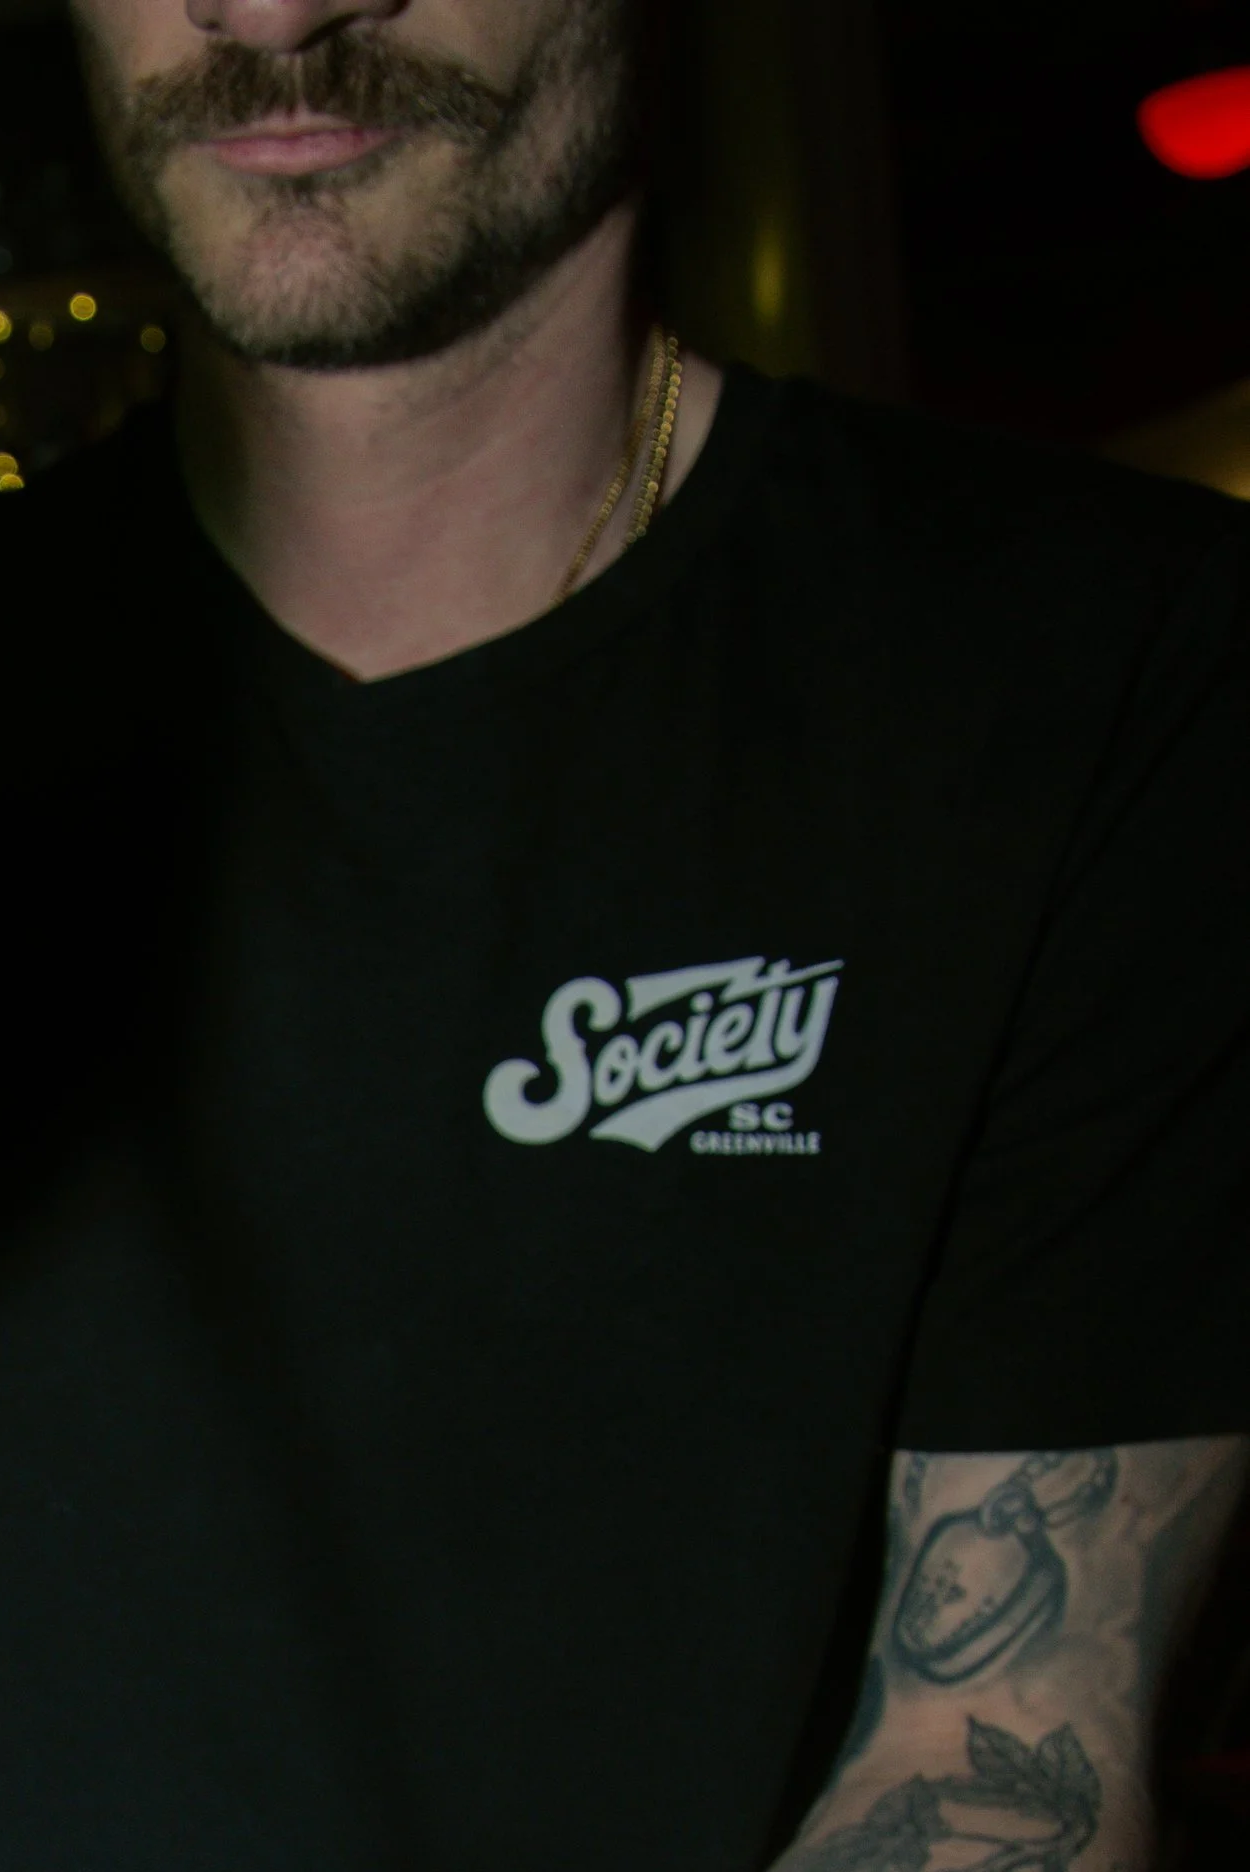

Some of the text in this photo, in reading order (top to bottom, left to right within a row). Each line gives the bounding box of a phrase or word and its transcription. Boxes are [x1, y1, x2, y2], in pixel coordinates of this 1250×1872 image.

[482, 955, 845, 1153] Society
[728, 1102, 794, 1132] SC
[690, 1131, 822, 1155] GREENVILLE
